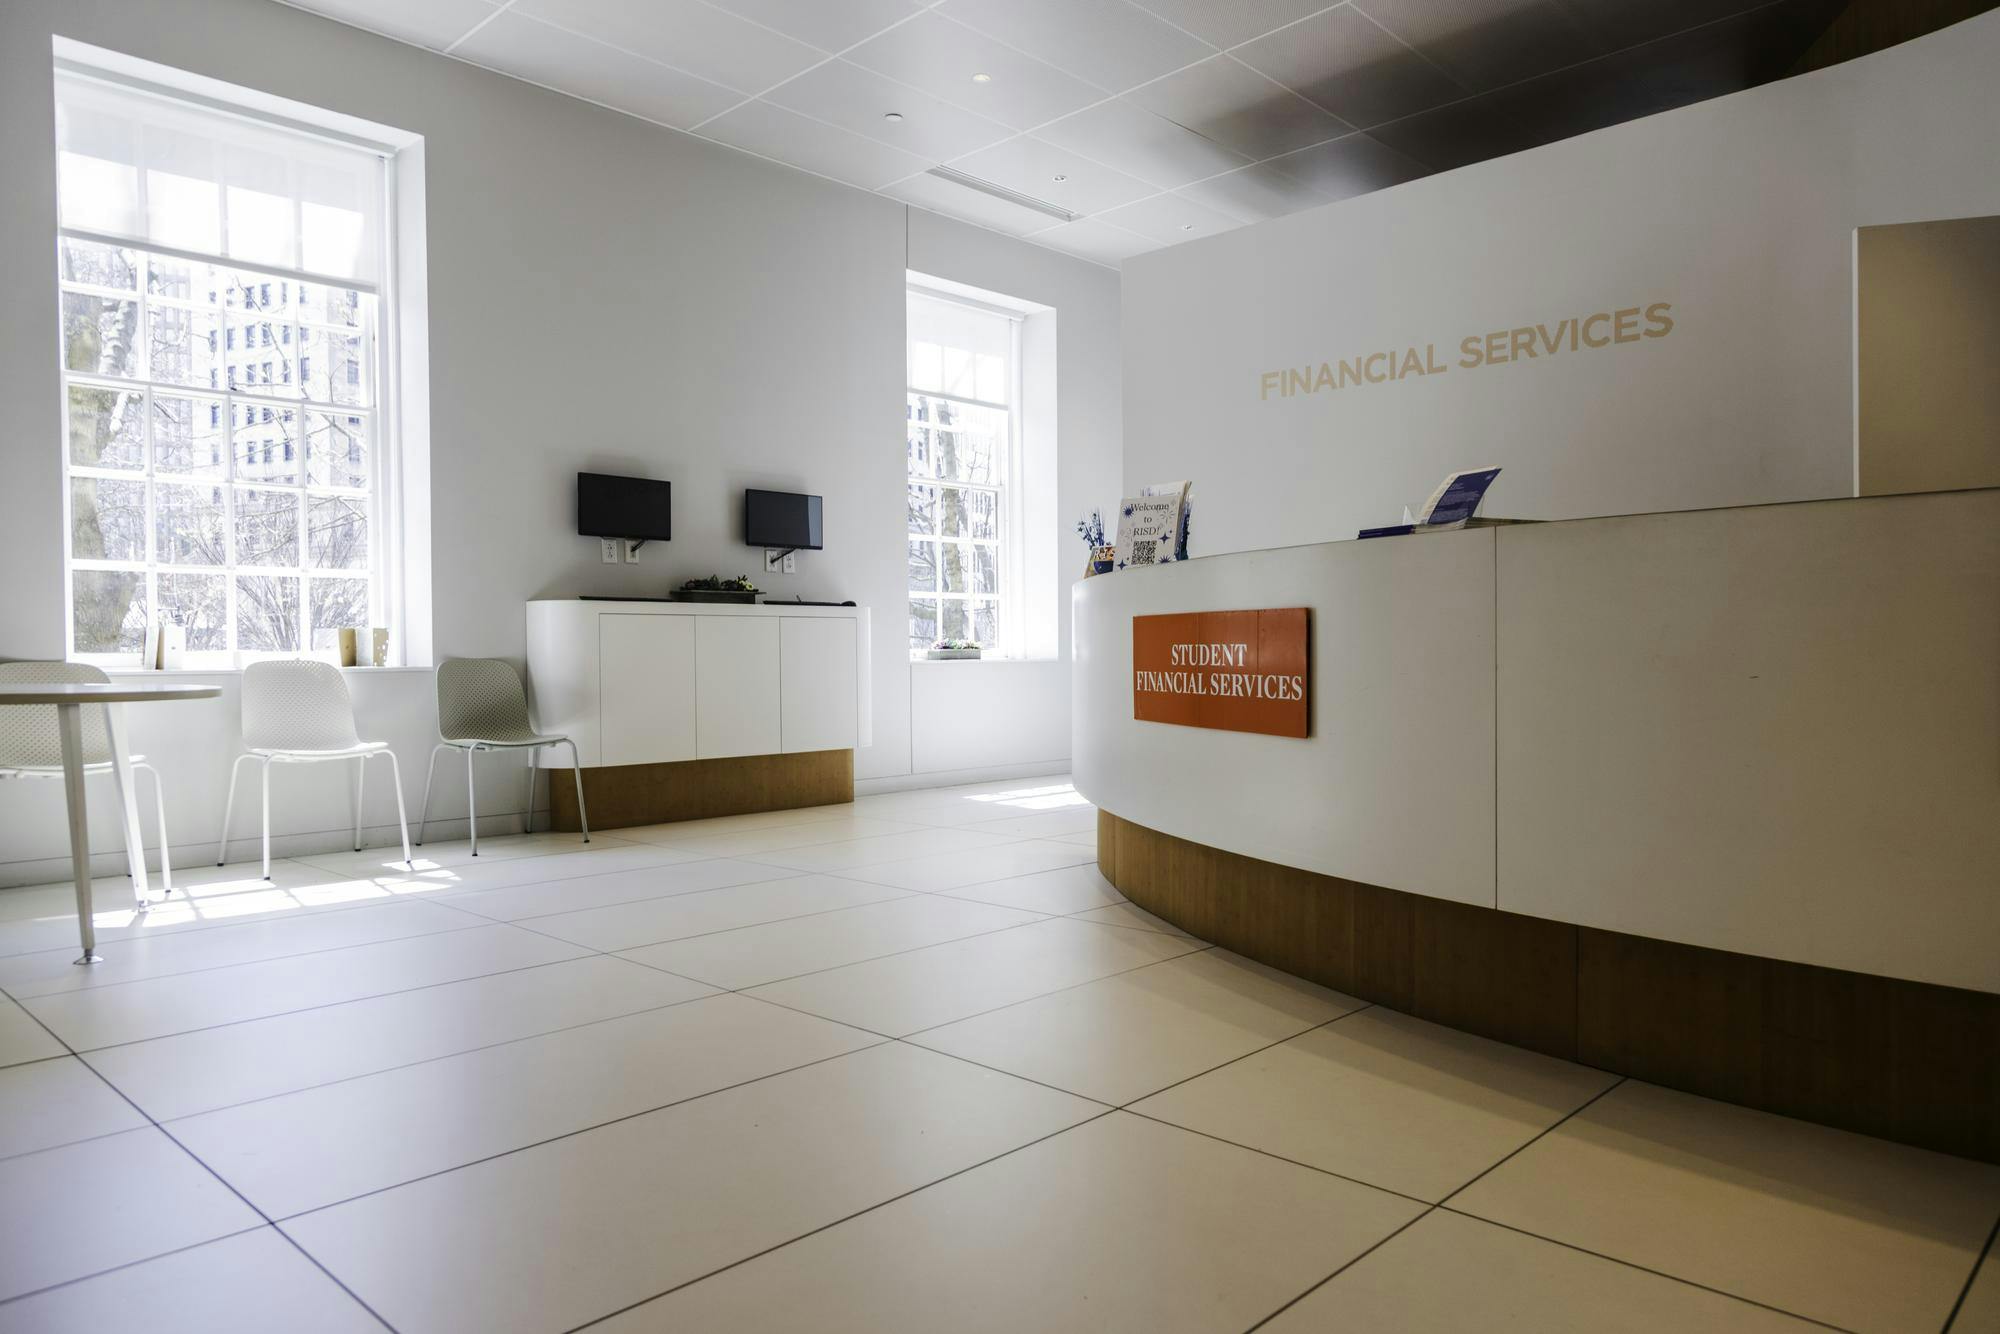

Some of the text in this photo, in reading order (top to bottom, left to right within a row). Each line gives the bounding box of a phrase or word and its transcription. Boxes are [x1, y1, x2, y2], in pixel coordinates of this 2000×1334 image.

[1260, 302, 1674, 400] FINANCIAL SERVICES
[1130, 503, 1169, 511] Welcome
[1133, 527, 1161, 536] RISD!
[1171, 644, 1247, 667] STUDENT
[1136, 671, 1302, 700] FINANCIAL SERVICES
